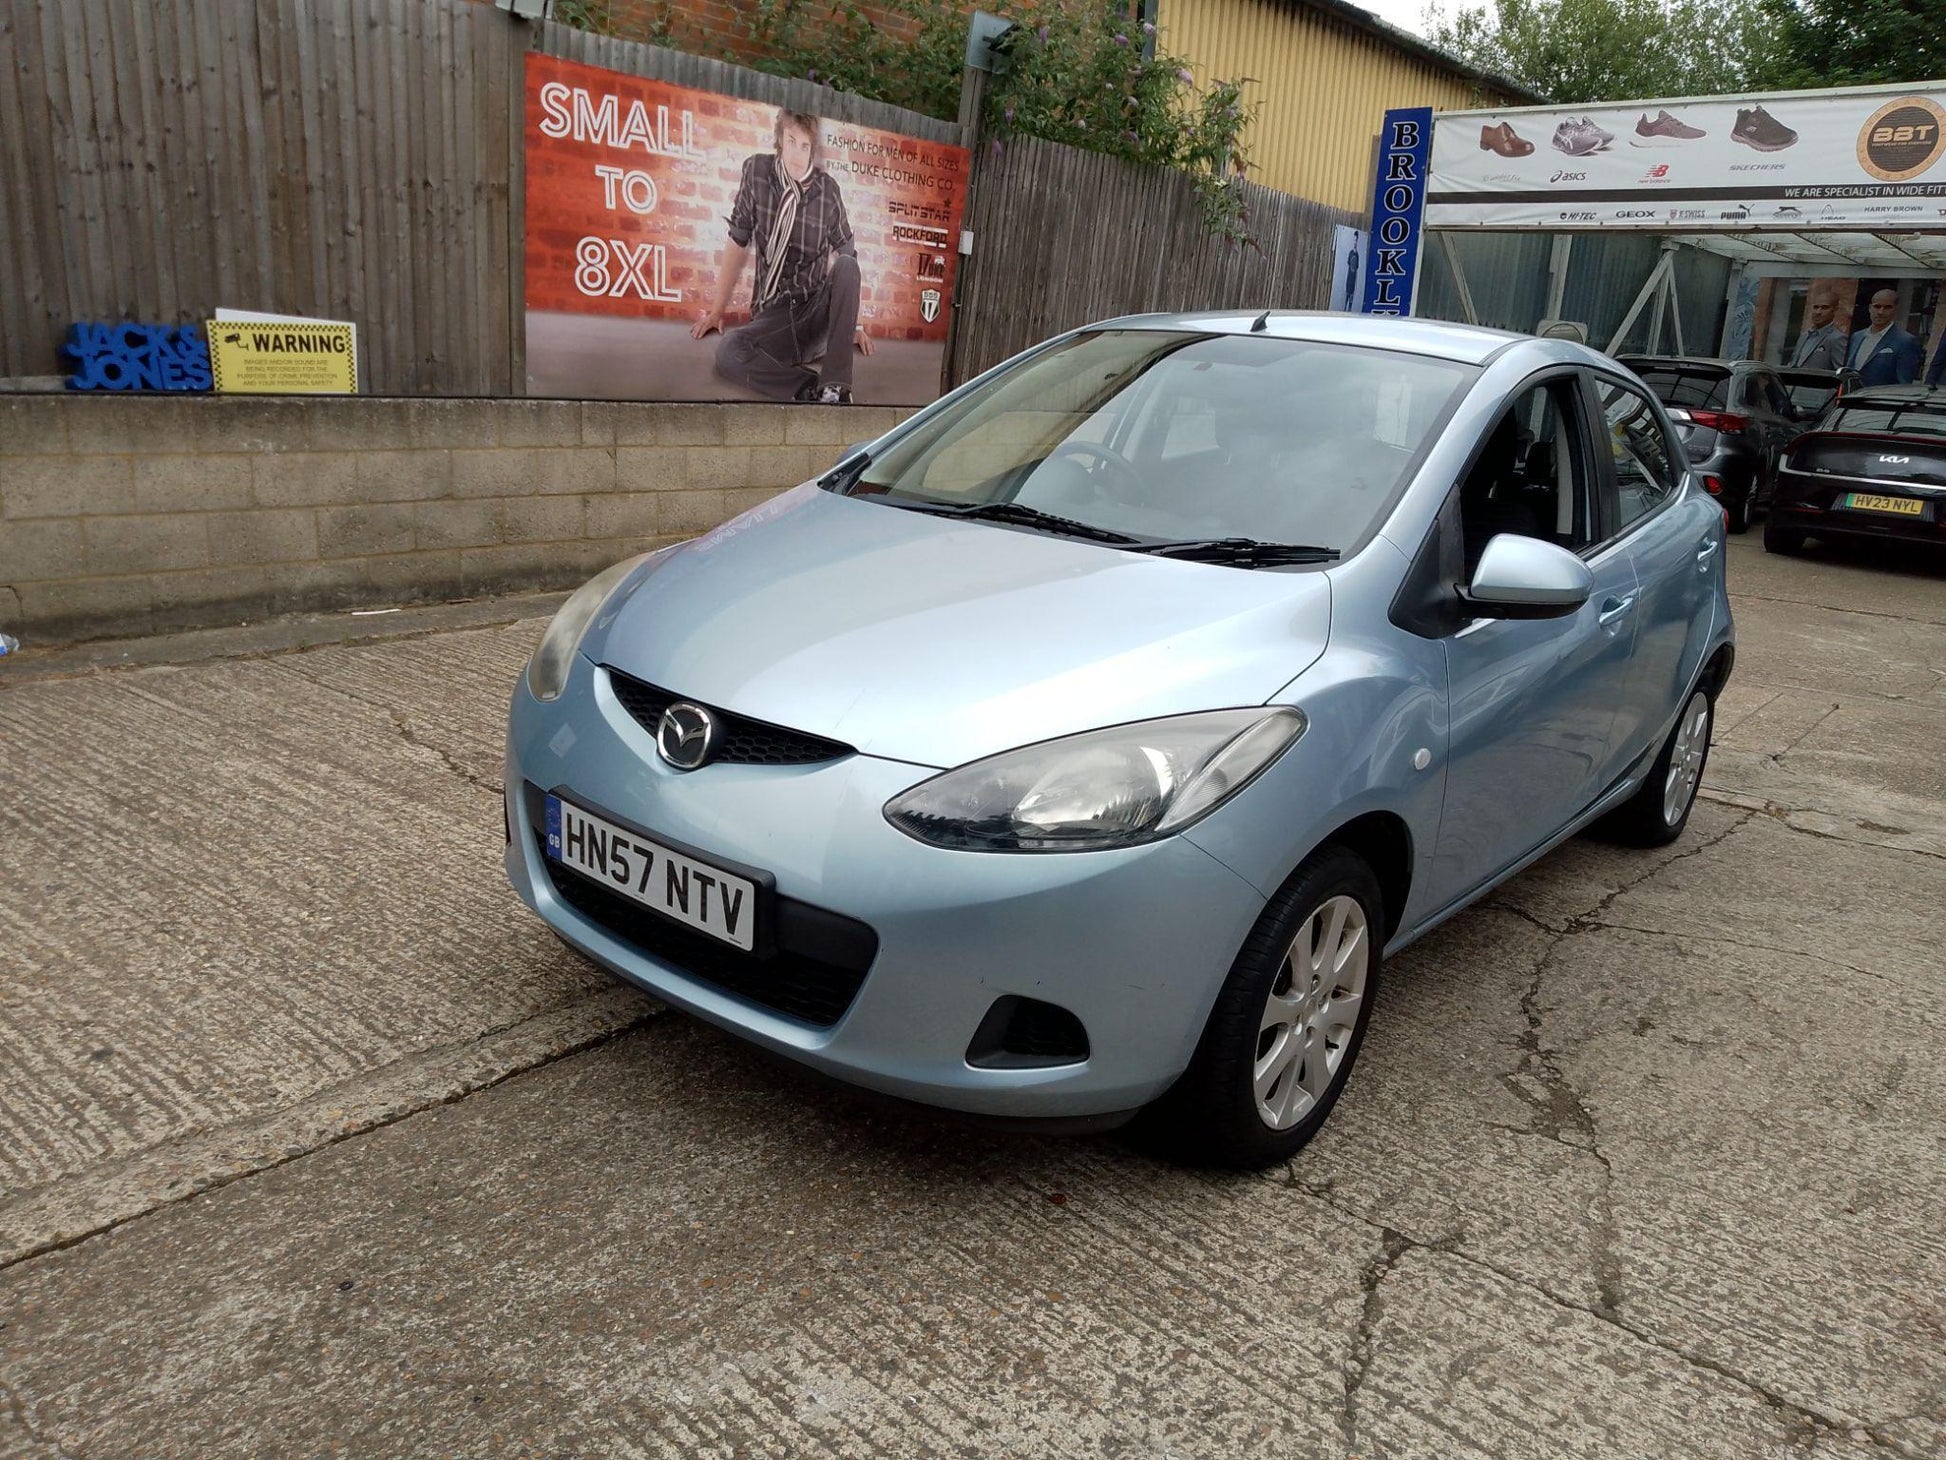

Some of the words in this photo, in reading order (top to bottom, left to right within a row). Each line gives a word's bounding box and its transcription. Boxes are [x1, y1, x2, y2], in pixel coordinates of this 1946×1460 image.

[539, 82, 706, 162] SMALL
[1872, 125, 1935, 142] BBT
[827, 134, 865, 152] FASHION
[867, 143, 884, 156] FOR
[885, 147, 904, 160] MEN
[906, 151, 918, 163] OF
[920, 154, 935, 167] ALL
[936, 158, 960, 172] SIZES
[836, 161, 849, 172] THE
[851, 161, 879, 177] DUKE
[881, 167, 934, 187] CLOTHING
[937, 178, 955, 191] CO.
[1728, 163, 1786, 171] SKECHERS
[595, 164, 658, 215] TO
[1785, 188, 1801, 198] WE
[1802, 187, 1823, 197] ARE
[1824, 186, 1881, 197] SPECIALIST
[1882, 186, 1894, 195] IN
[1896, 185, 1924, 196] WIDE
[1371, 121, 1419, 316] BROOKL
[1568, 211, 1597, 221] HI-TEC
[1720, 211, 1746, 220] PUMA
[892, 225, 948, 243] ROCKFORD
[575, 236, 682, 303] 8XL
[67, 322, 174, 358] JACK
[177, 325, 208, 358] &
[252, 333, 345, 353] WARNING
[72, 355, 212, 391] JONES
[1855, 495, 1890, 509] HV23
[1892, 499, 1918, 512] NYL
[549, 833, 560, 849] GB
[566, 812, 654, 895] HN57
[666, 859, 744, 936] NTV
